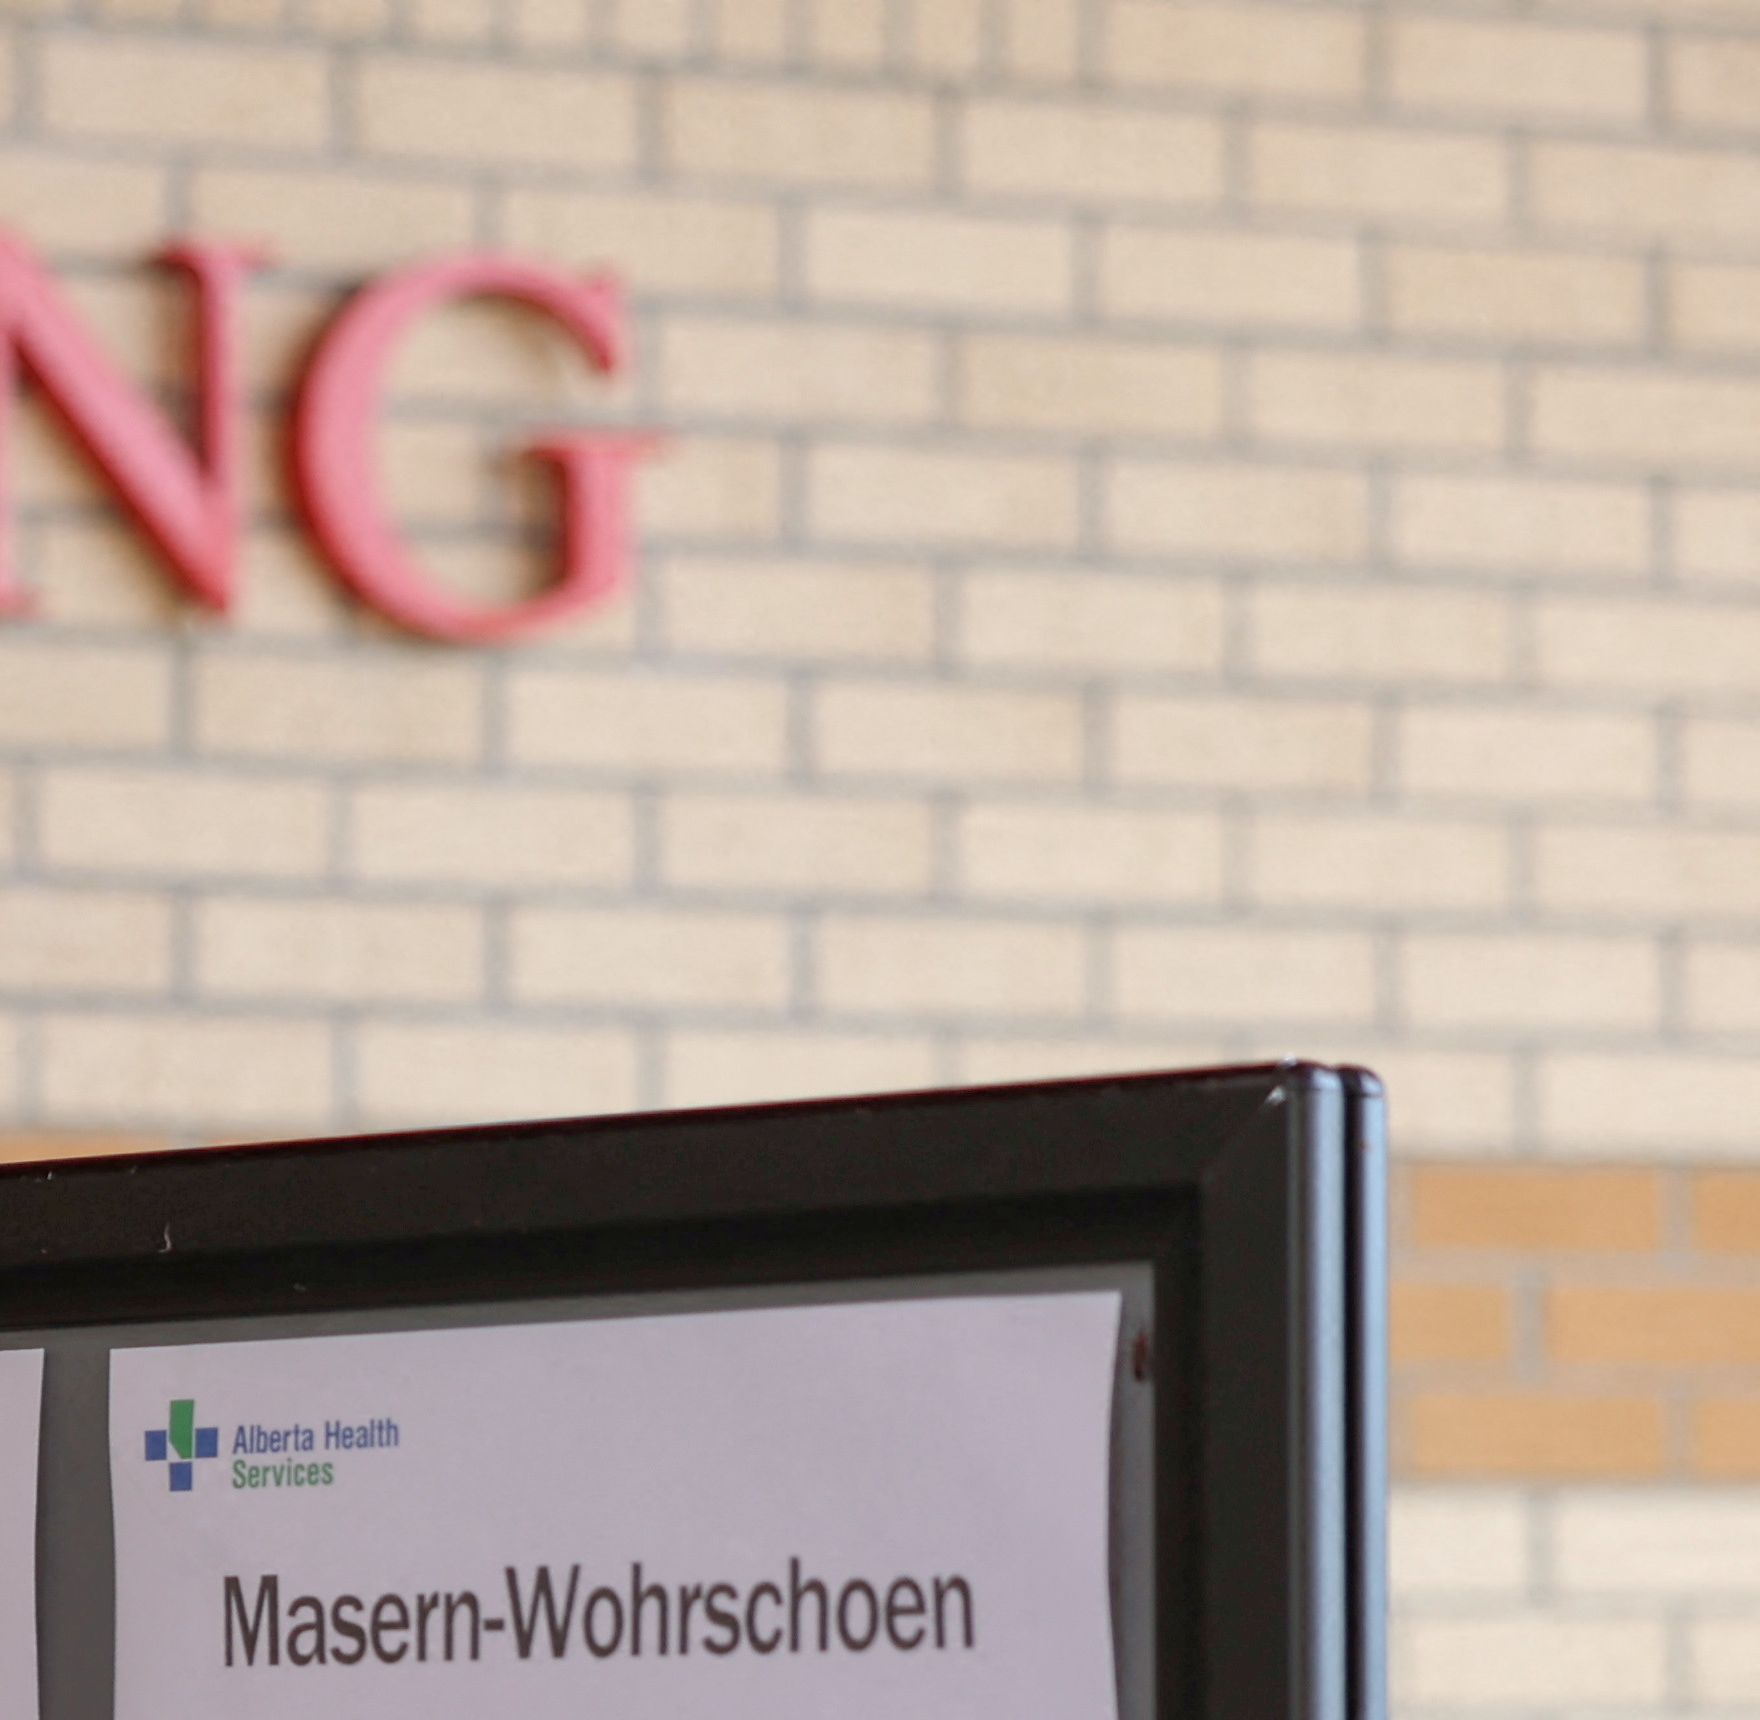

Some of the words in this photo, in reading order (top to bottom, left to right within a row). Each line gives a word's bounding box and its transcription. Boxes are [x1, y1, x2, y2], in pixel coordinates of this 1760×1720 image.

[233, 1424, 314, 1454] Alberta
[325, 1418, 399, 1450] Health
[232, 1458, 333, 1489] Services
[224, 1557, 974, 1667] Masern-Wohrschoen
